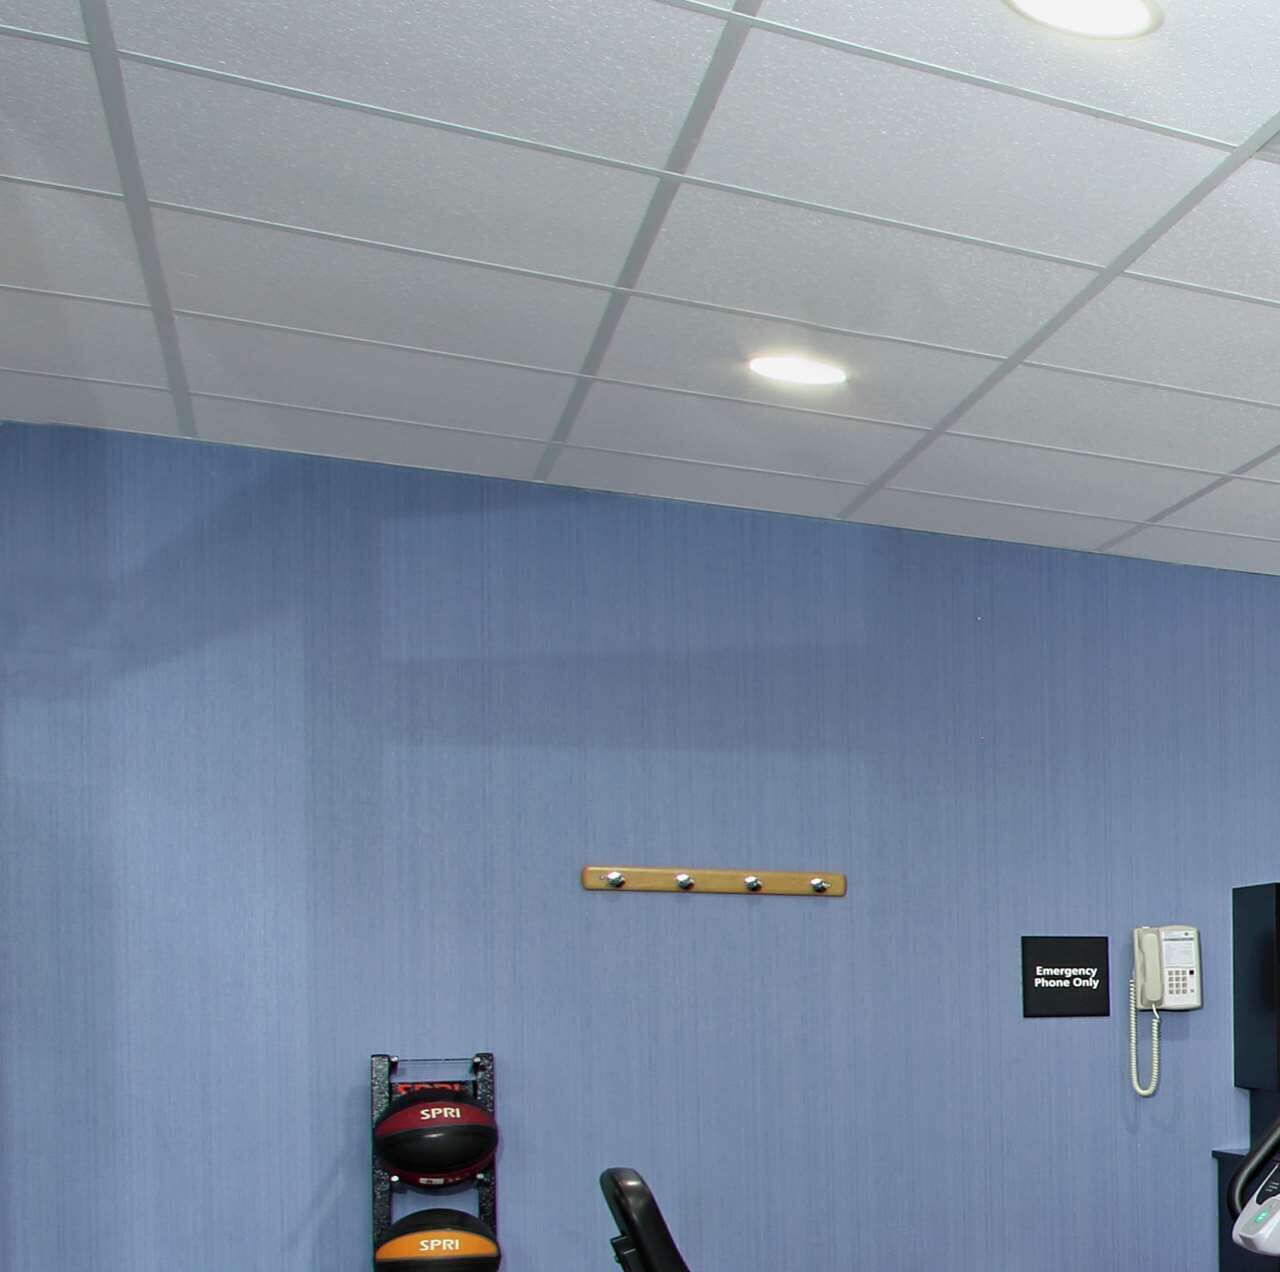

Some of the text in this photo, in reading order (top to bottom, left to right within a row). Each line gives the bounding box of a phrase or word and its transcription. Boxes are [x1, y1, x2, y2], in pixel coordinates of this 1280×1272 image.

[1035, 966, 1098, 978] Emergency
[1034, 977, 1100, 989] Phone Only
[420, 1107, 461, 1120] SPRI
[419, 1239, 460, 1252] SPRI
